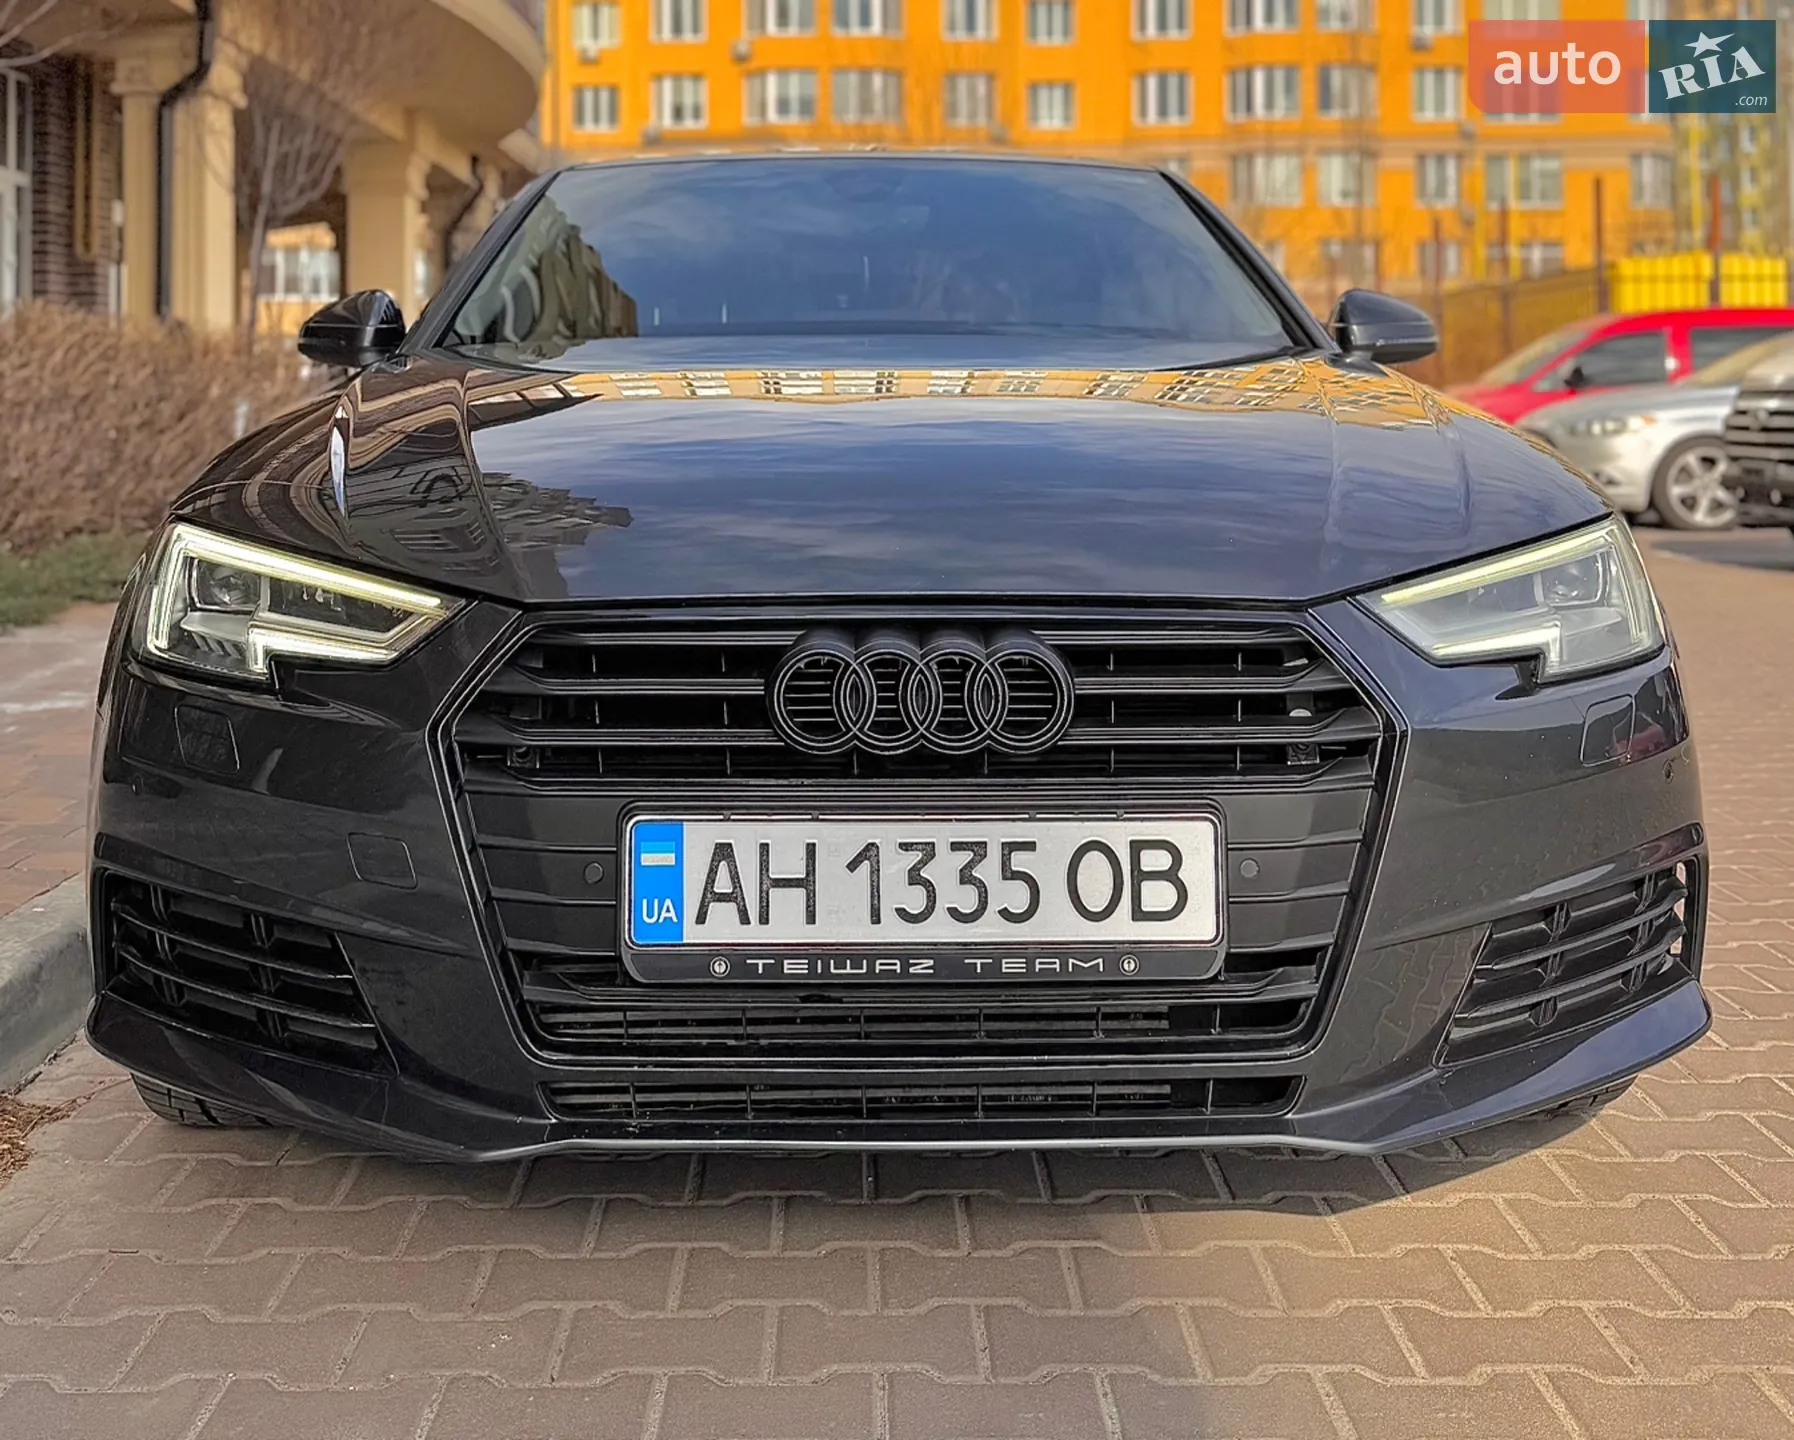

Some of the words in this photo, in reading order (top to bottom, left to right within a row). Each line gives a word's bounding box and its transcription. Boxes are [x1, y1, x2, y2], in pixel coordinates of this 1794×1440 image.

[694, 841, 818, 926] AH
[845, 840, 1040, 925] 1335
[1066, 838, 1190, 923] OB
[641, 898, 677, 924] UA
[746, 958, 936, 975] TEIWAZ
[964, 957, 1105, 974] TEAM
